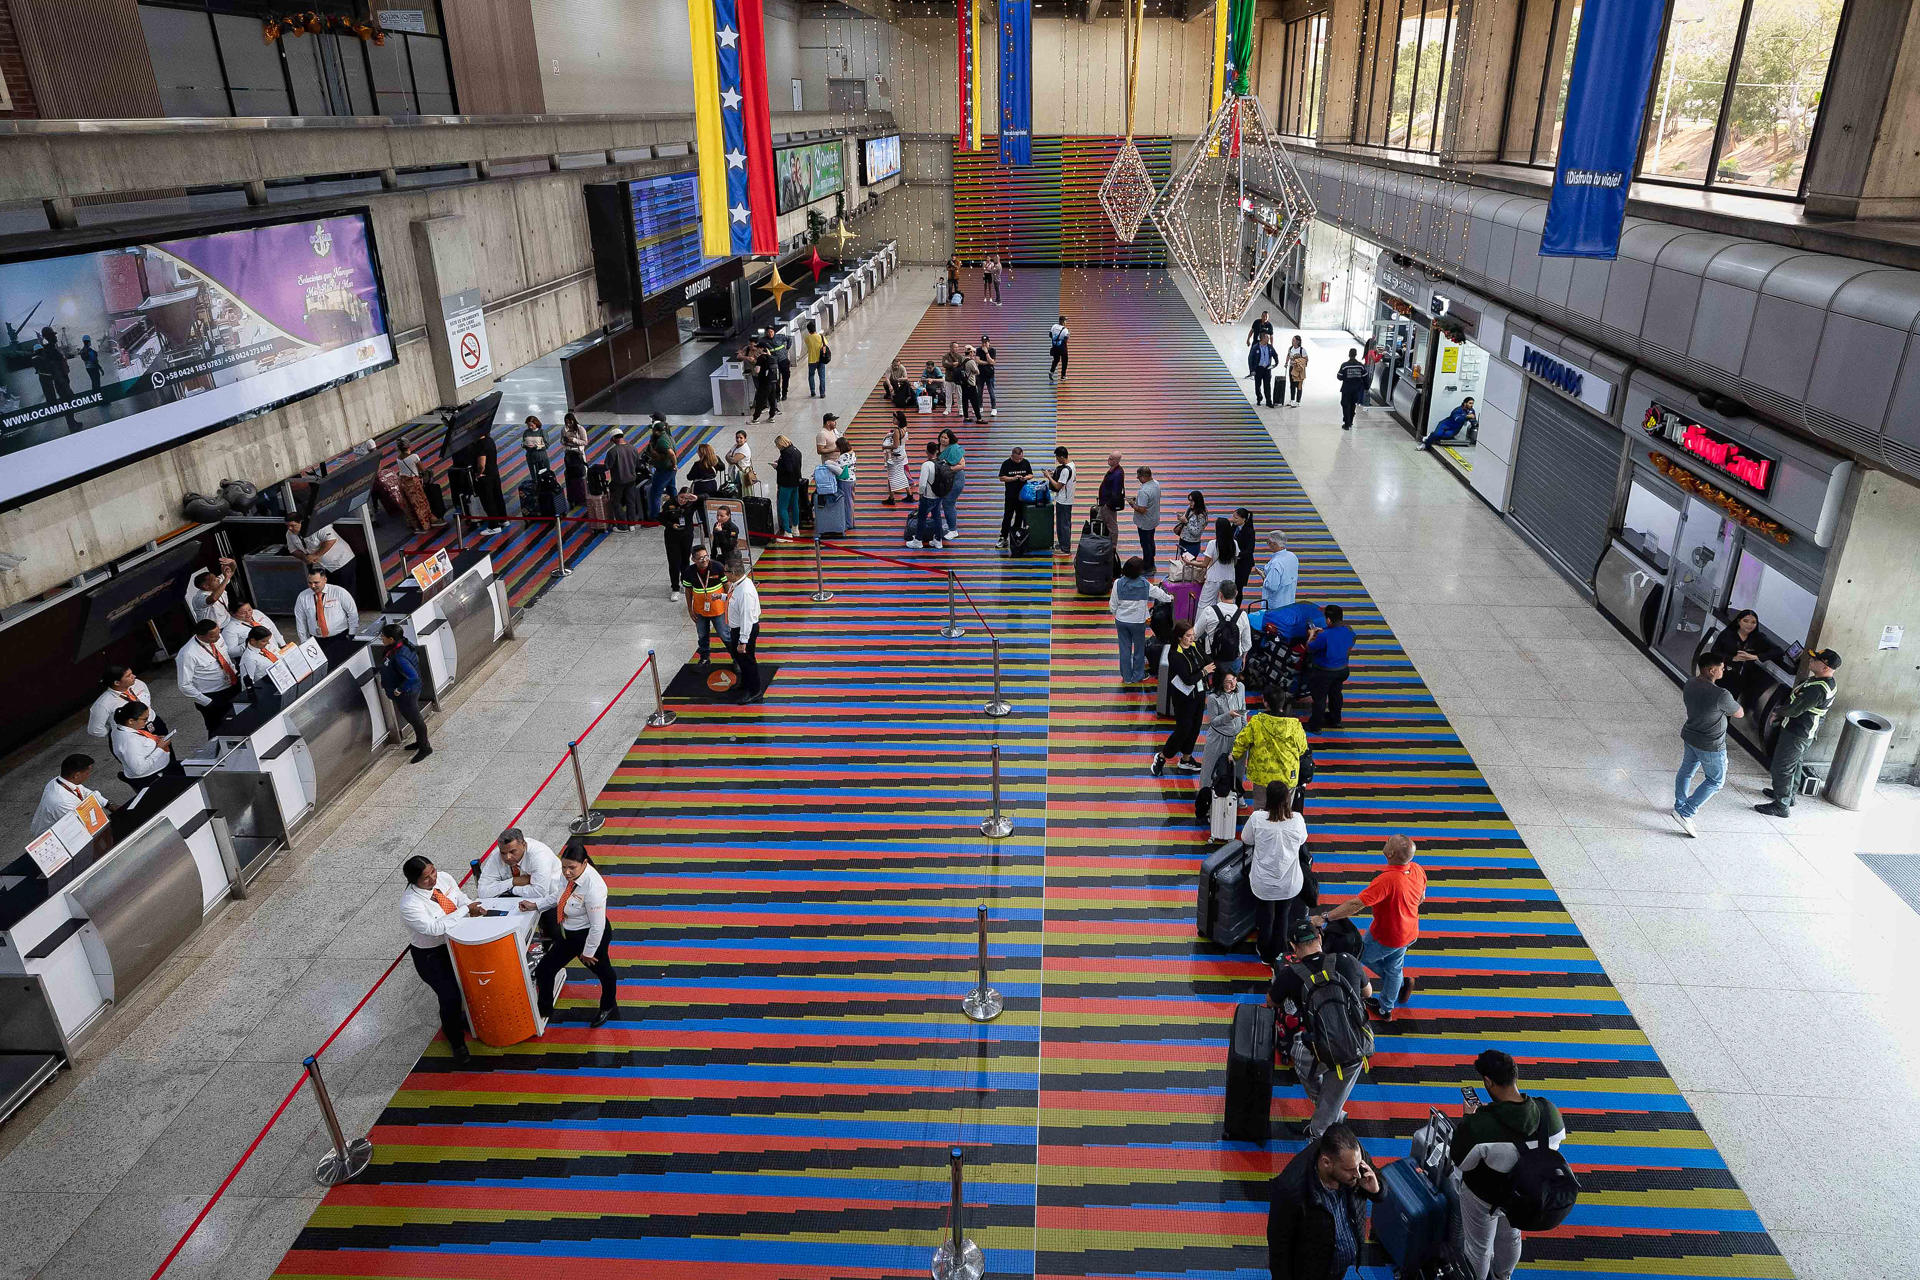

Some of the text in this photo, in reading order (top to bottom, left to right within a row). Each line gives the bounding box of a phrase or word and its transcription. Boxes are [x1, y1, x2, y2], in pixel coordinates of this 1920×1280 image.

[1593, 172, 1601, 186] tu
[1601, 173, 1622, 187] viaje!
[684, 275, 711, 300] SAMSUNG
[165, 370, 178, 381] +58
[178, 366, 195, 377] 0424
[196, 363, 207, 372] 185
[224, 354, 236, 363] +58
[2, 392, 104, 428] WWW.OCAMAR.COM.VE
